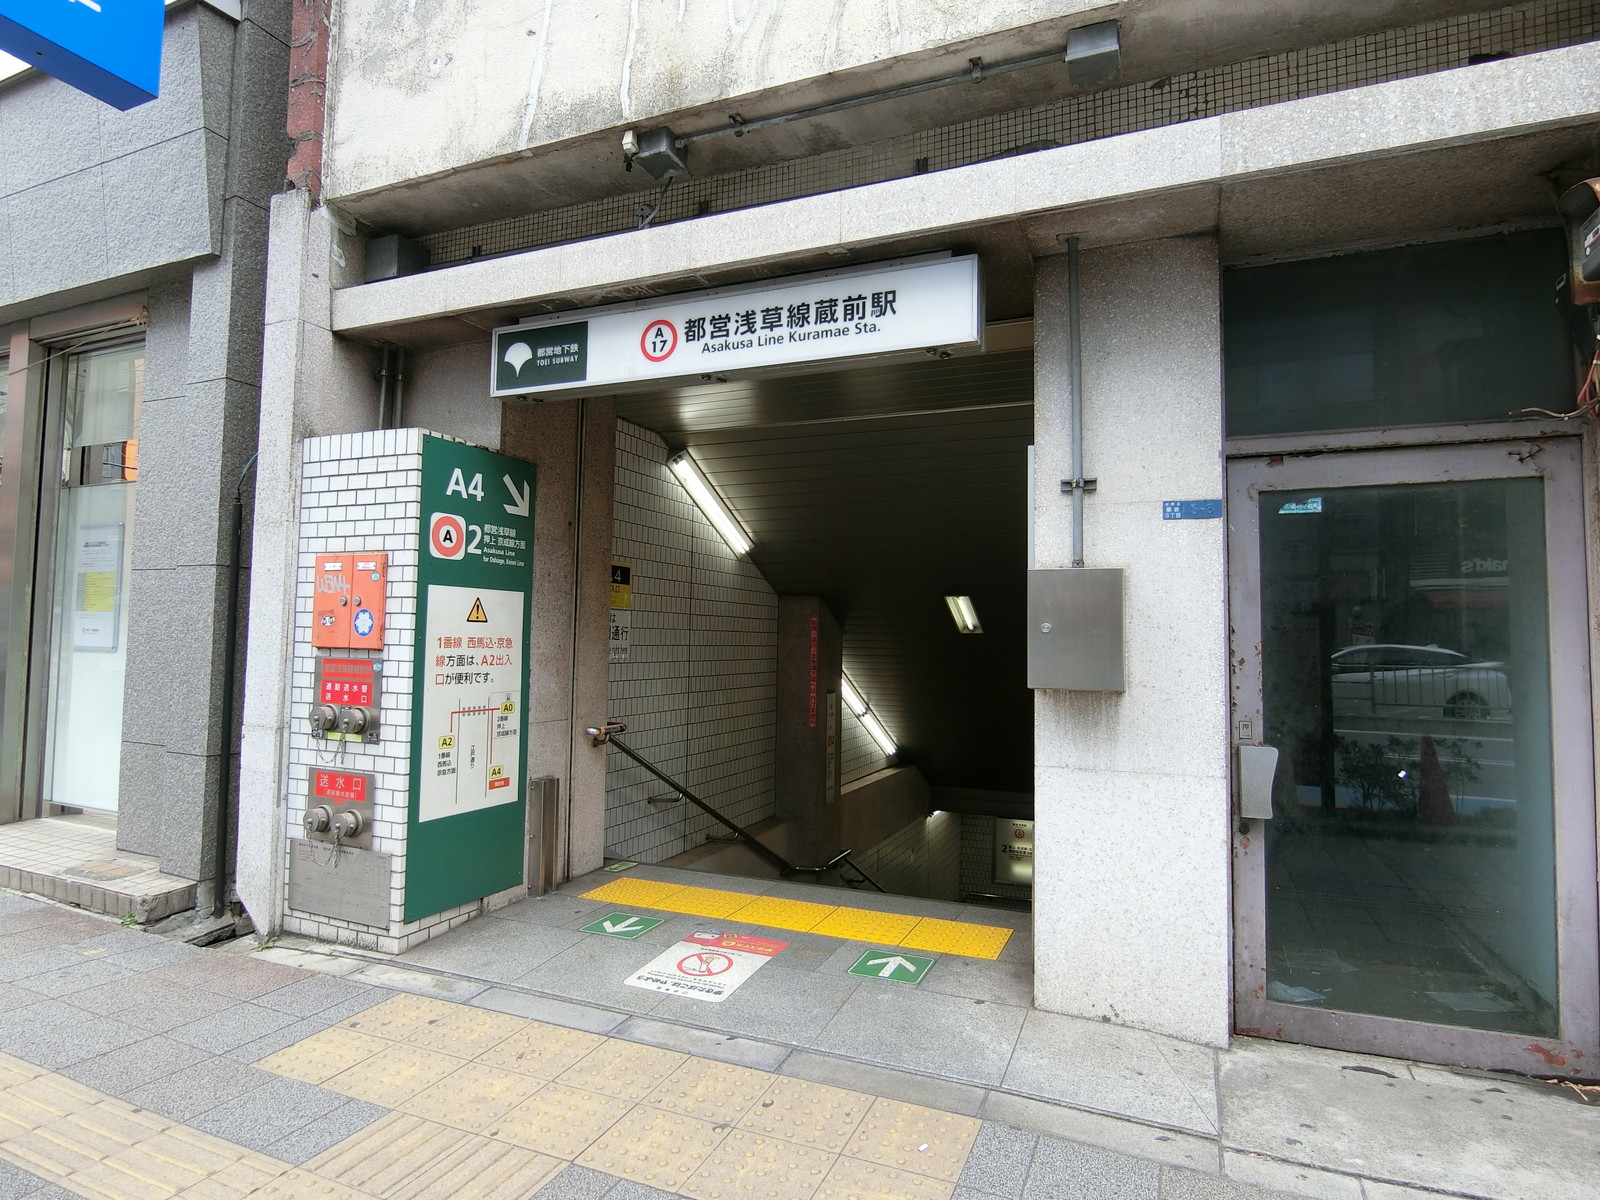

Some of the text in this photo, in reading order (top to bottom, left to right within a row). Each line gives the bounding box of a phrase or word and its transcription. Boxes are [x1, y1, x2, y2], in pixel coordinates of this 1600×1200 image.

[684, 289, 897, 343] 都営浅草線蔵前駅
[654, 327, 664, 338] A
[701, 321, 881, 354] Asakusa Line Kuramae Sta.
[536, 343, 579, 358] 都営地下鉄
[651, 339, 668, 353] 17
[536, 355, 579, 367] TOEI SUBWAY
[445, 467, 485, 502] A4
[442, 529, 454, 544] A
[467, 524, 482, 554] 2
[483, 547, 504, 555] Asakusa
[609, 625, 629, 641] 通行
[437, 636, 462, 649] 1番線
[435, 654, 513, 668] 線方面は、A2出入
[435, 672, 494, 685] 口が便利です。
[325, 692, 368, 703] 送水口
[503, 703, 513, 712] A0
[441, 737, 453, 747] A2
[491, 767, 501, 777] A4
[320, 774, 361, 791] 送水口
